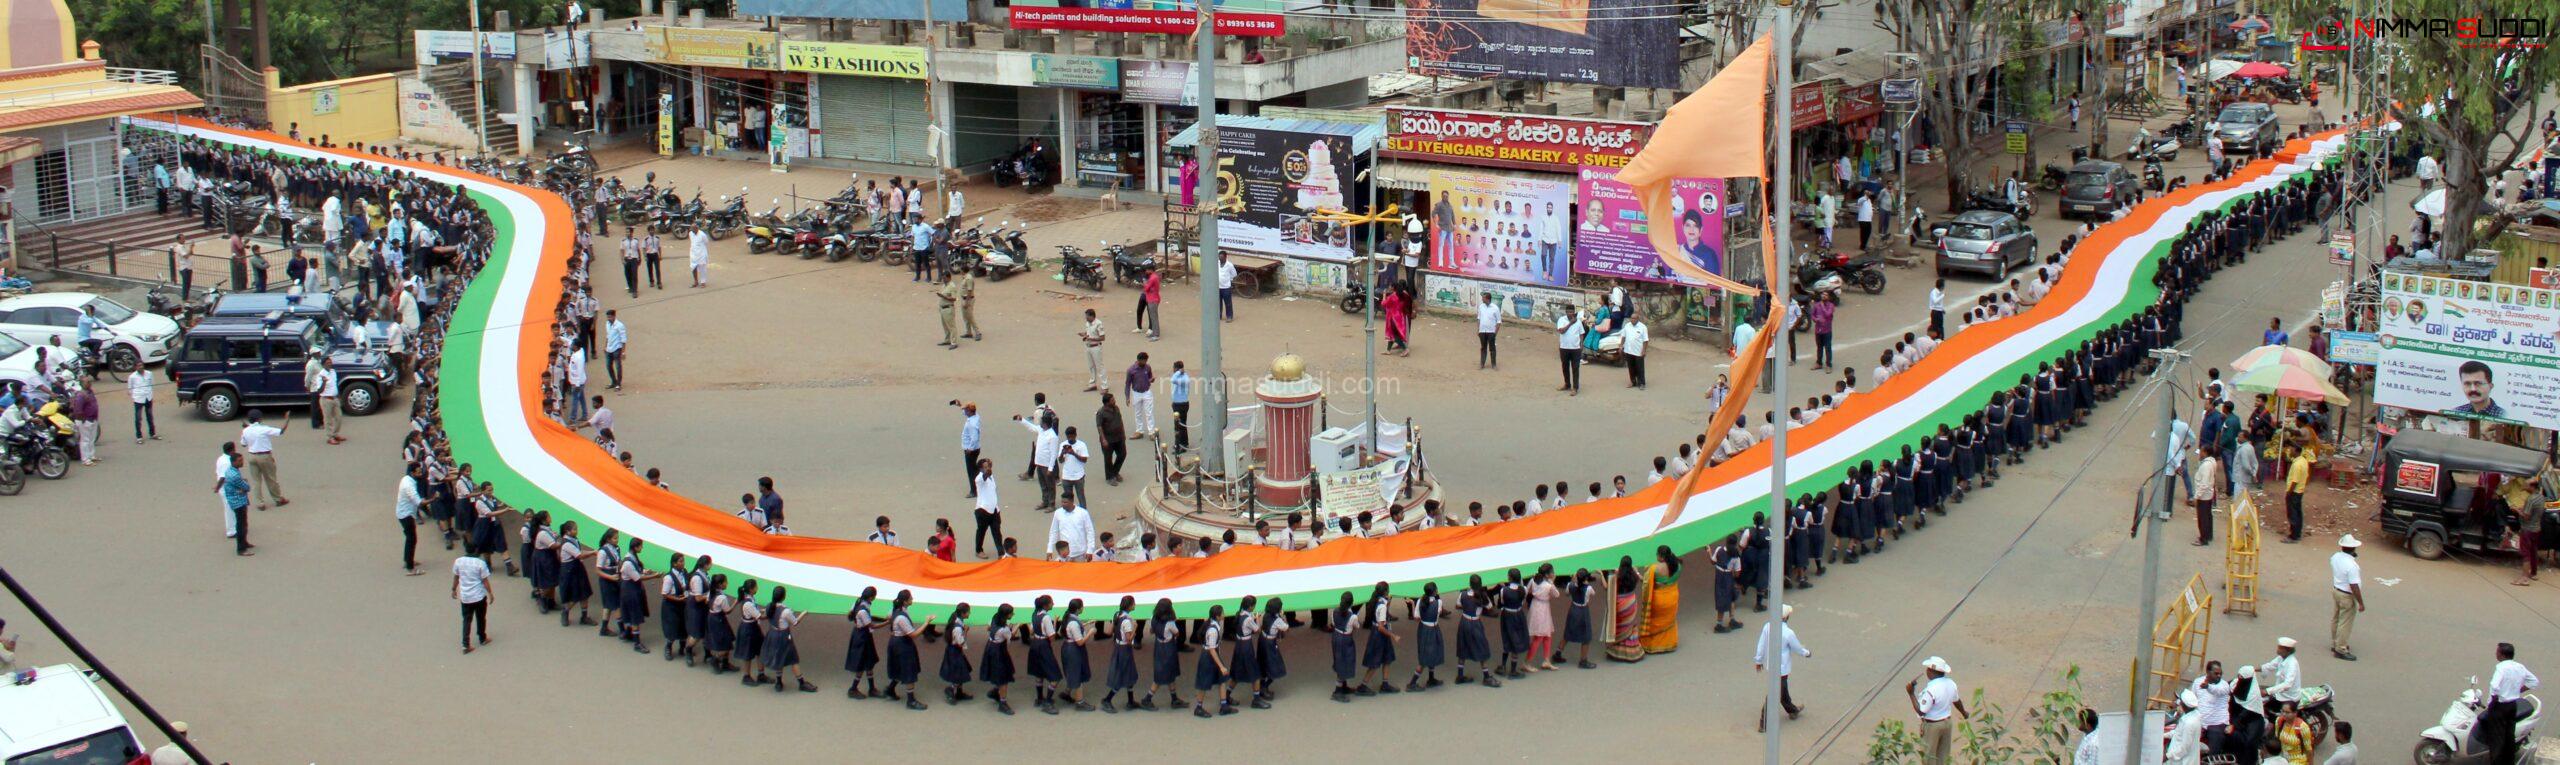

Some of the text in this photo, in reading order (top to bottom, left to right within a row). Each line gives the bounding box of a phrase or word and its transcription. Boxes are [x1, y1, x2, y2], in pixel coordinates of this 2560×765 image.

[1015, 11, 1040, 20] Hi-tech
[1042, 12, 1065, 22] paints
[1066, 13, 1081, 22] and
[1082, 13, 1114, 24] building
[1115, 15, 1151, 24] solutions
[788, 54, 920, 75] W 3 FASHIONS
[1507, 119, 1564, 144] ಬೇಕರಿ
[1566, 127, 1580, 145] &
[1228, 148, 1257, 157] Celebrating
[1388, 138, 1414, 151] SLJ
[1418, 140, 1496, 158] IYENGARS
[1500, 146, 1562, 164] BAKERY
[1567, 152, 1579, 164] &
[1588, 260, 1614, 269] 90197
[2452, 324, 2497, 342] ಪ್ರಕಾಶ್
